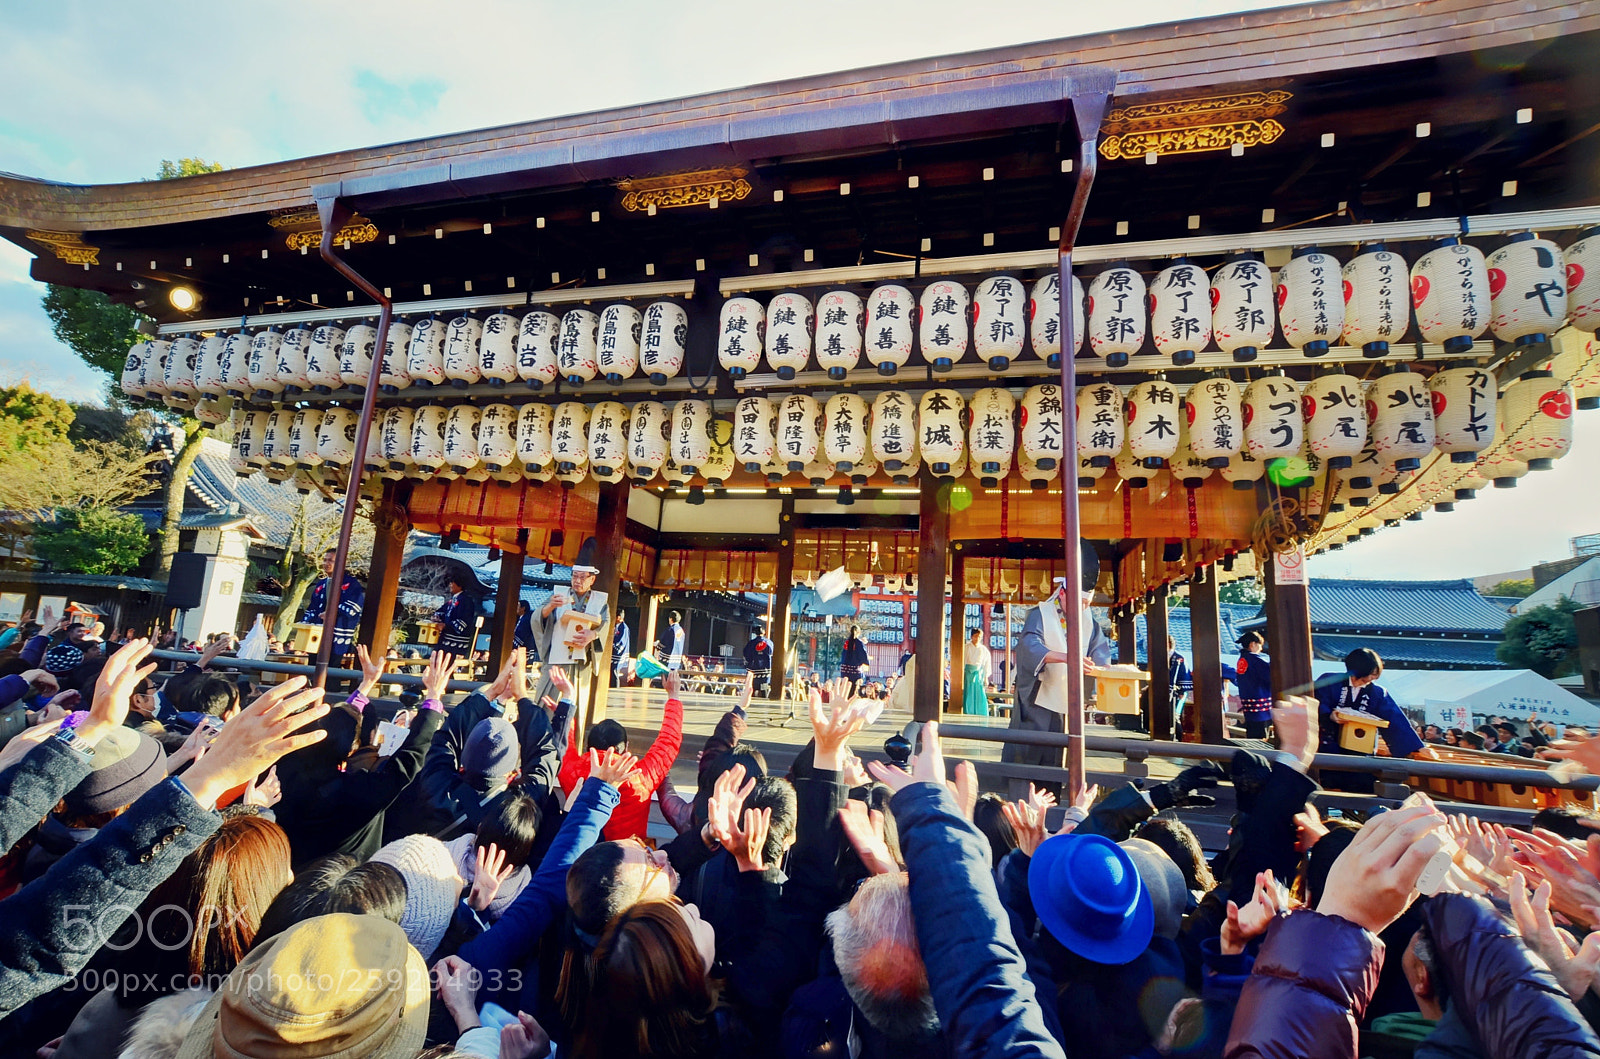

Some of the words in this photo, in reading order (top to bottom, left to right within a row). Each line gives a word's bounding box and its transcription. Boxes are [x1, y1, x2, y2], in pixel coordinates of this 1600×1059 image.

[931, 295, 958, 347] 鍵善
[987, 279, 1014, 343] 原了郭
[1102, 270, 1135, 343] 原了郭
[1164, 266, 1200, 342] 原了郭
[1230, 262, 1265, 334] 原了郭
[1310, 266, 1329, 336] かづら清老舗
[1378, 264, 1393, 337] かづら清老舗
[1457, 256, 1477, 331] かづら清老舗
[409, 330, 427, 371] よしだ
[446, 329, 464, 370] よしだ
[482, 317, 501, 369] 菱岩
[519, 313, 541, 368] 菱岩
[601, 308, 620, 366] 松島和彦
[645, 304, 664, 366] 松島和彦
[724, 315, 749, 357] 鍵善
[772, 307, 798, 356] 鍵善
[823, 307, 849, 357] 鍵善
[875, 300, 902, 350] 鍵善
[520, 407, 540, 453] 井澤屋
[739, 398, 760, 455] 武田隆久
[785, 396, 806, 455] 武田隆司
[881, 391, 907, 454] 大橋進也
[924, 392, 953, 446] 本城
[983, 413, 1004, 449] 松葉
[1091, 386, 1116, 449] 重兵衛
[1145, 384, 1176, 440] 柏木
[1206, 381, 1232, 450] (有)さのや電気
[1267, 382, 1298, 448] いづう
[1321, 385, 1360, 438] 北尾
[1388, 384, 1427, 444] 北尾
[1463, 371, 1488, 442] カトレヤ
